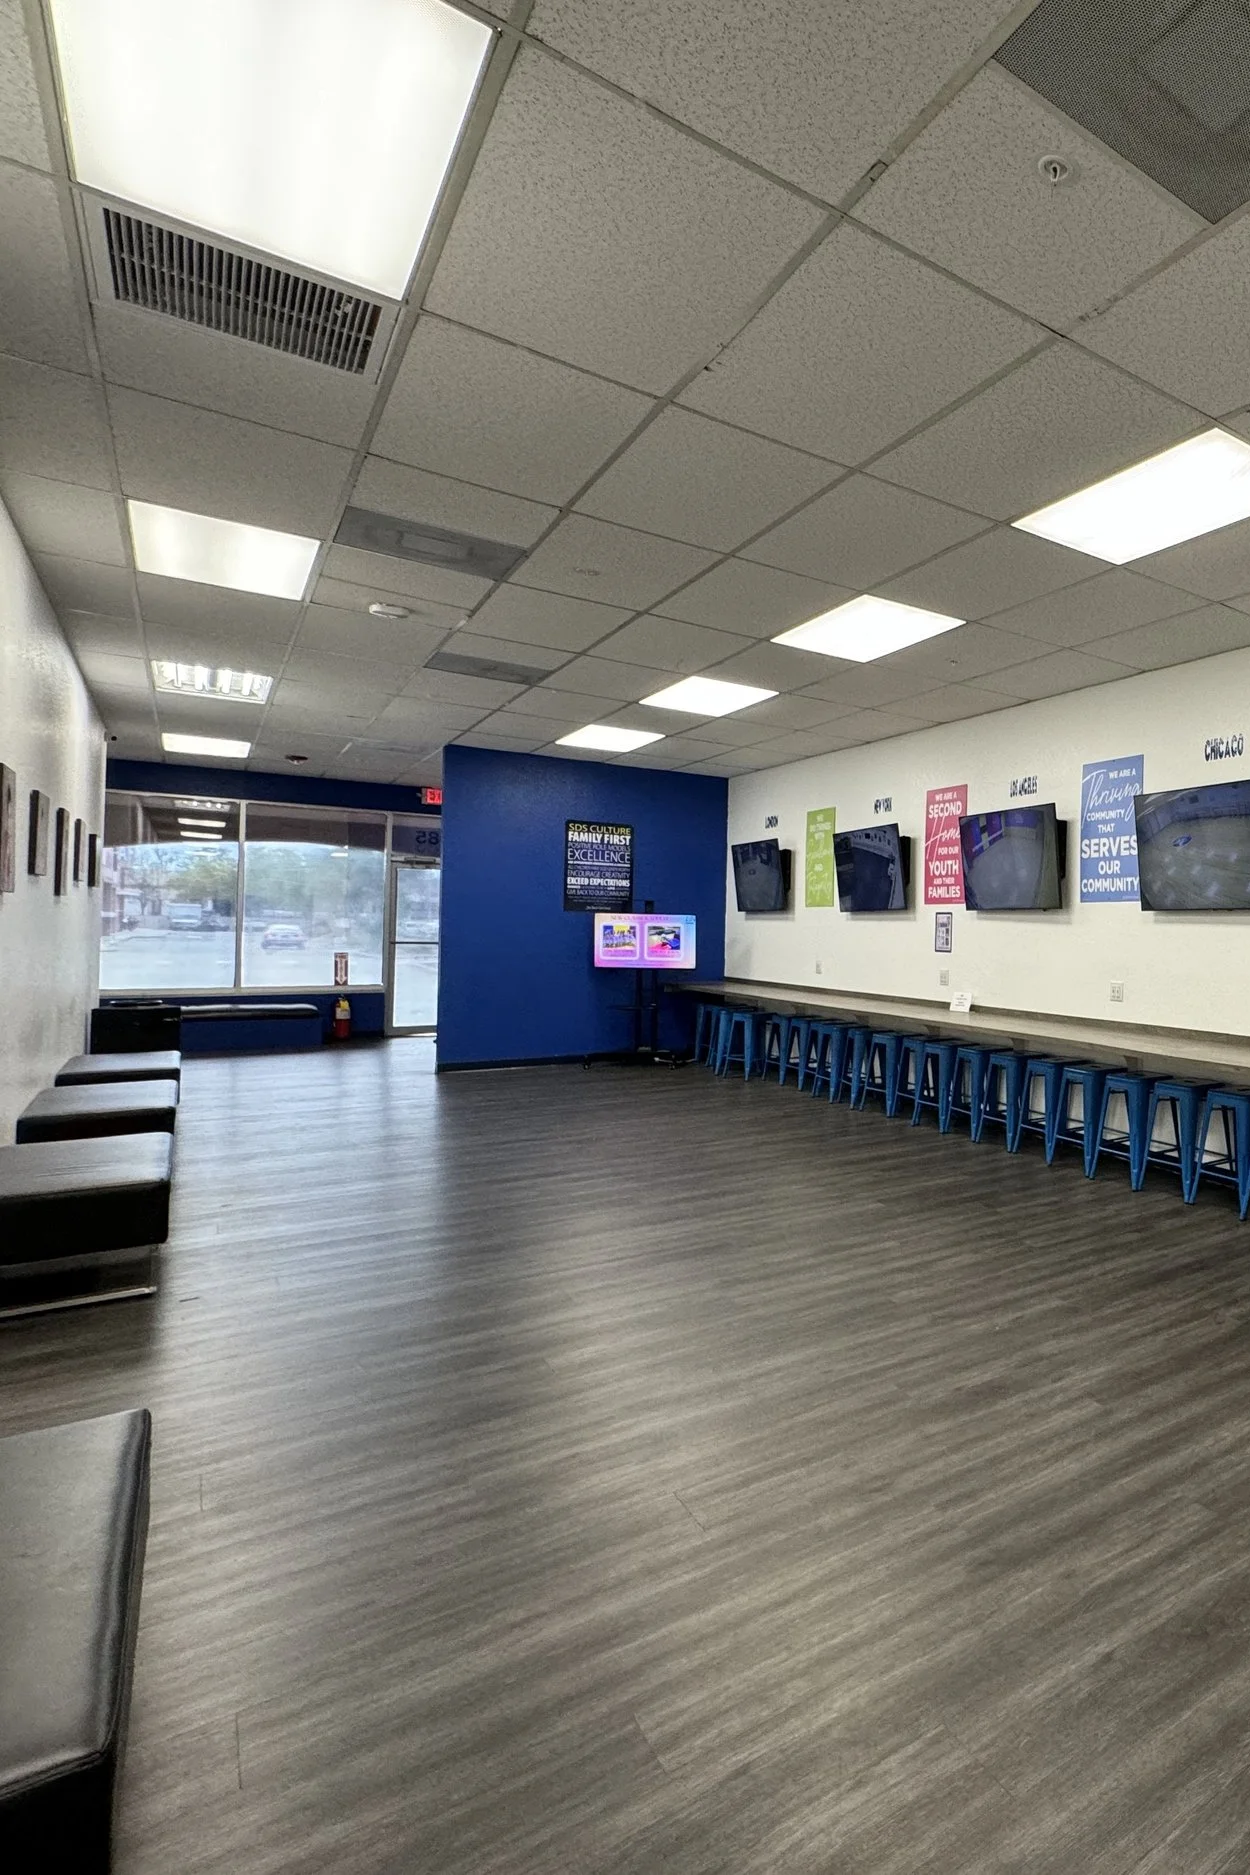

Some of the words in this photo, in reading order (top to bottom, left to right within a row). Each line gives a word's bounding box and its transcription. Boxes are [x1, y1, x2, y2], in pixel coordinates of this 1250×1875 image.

[1204, 733, 1244, 761] CHICAGO
[1109, 771, 1119, 779] WE
[1120, 769, 1131, 777] ARE
[1132, 768, 1136, 776] A
[1009, 779, 1018, 798] LOS
[1018, 775, 1038, 796] ANGELES
[935, 794, 943, 802] WE
[943, 792, 953, 800] ARE
[1081, 769, 1142, 829] Thriving
[928, 800, 962, 819] SECOND
[1086, 809, 1125, 822] COMMUNITY
[569, 823, 588, 832] SDS
[590, 825, 631, 835] CULTURE
[1097, 823, 1116, 834] THAT
[568, 831, 602, 843] FAMILY
[604, 834, 631, 845] FIRST
[938, 847, 948, 855] FOR
[949, 846, 959, 855] OUR
[1081, 835, 1138, 859] SERVES
[567, 848, 630, 863] EXCELLENCE
[567, 870, 600, 878] ENCOURAGE
[928, 860, 960, 876] YOUTH
[1098, 860, 1121, 875] OUR
[567, 876, 589, 885] EXCEED
[590, 878, 630, 887] EXPECTATIONS
[1081, 877, 1140, 893] COMMUNITY
[928, 886, 960, 898] FAMILIES
